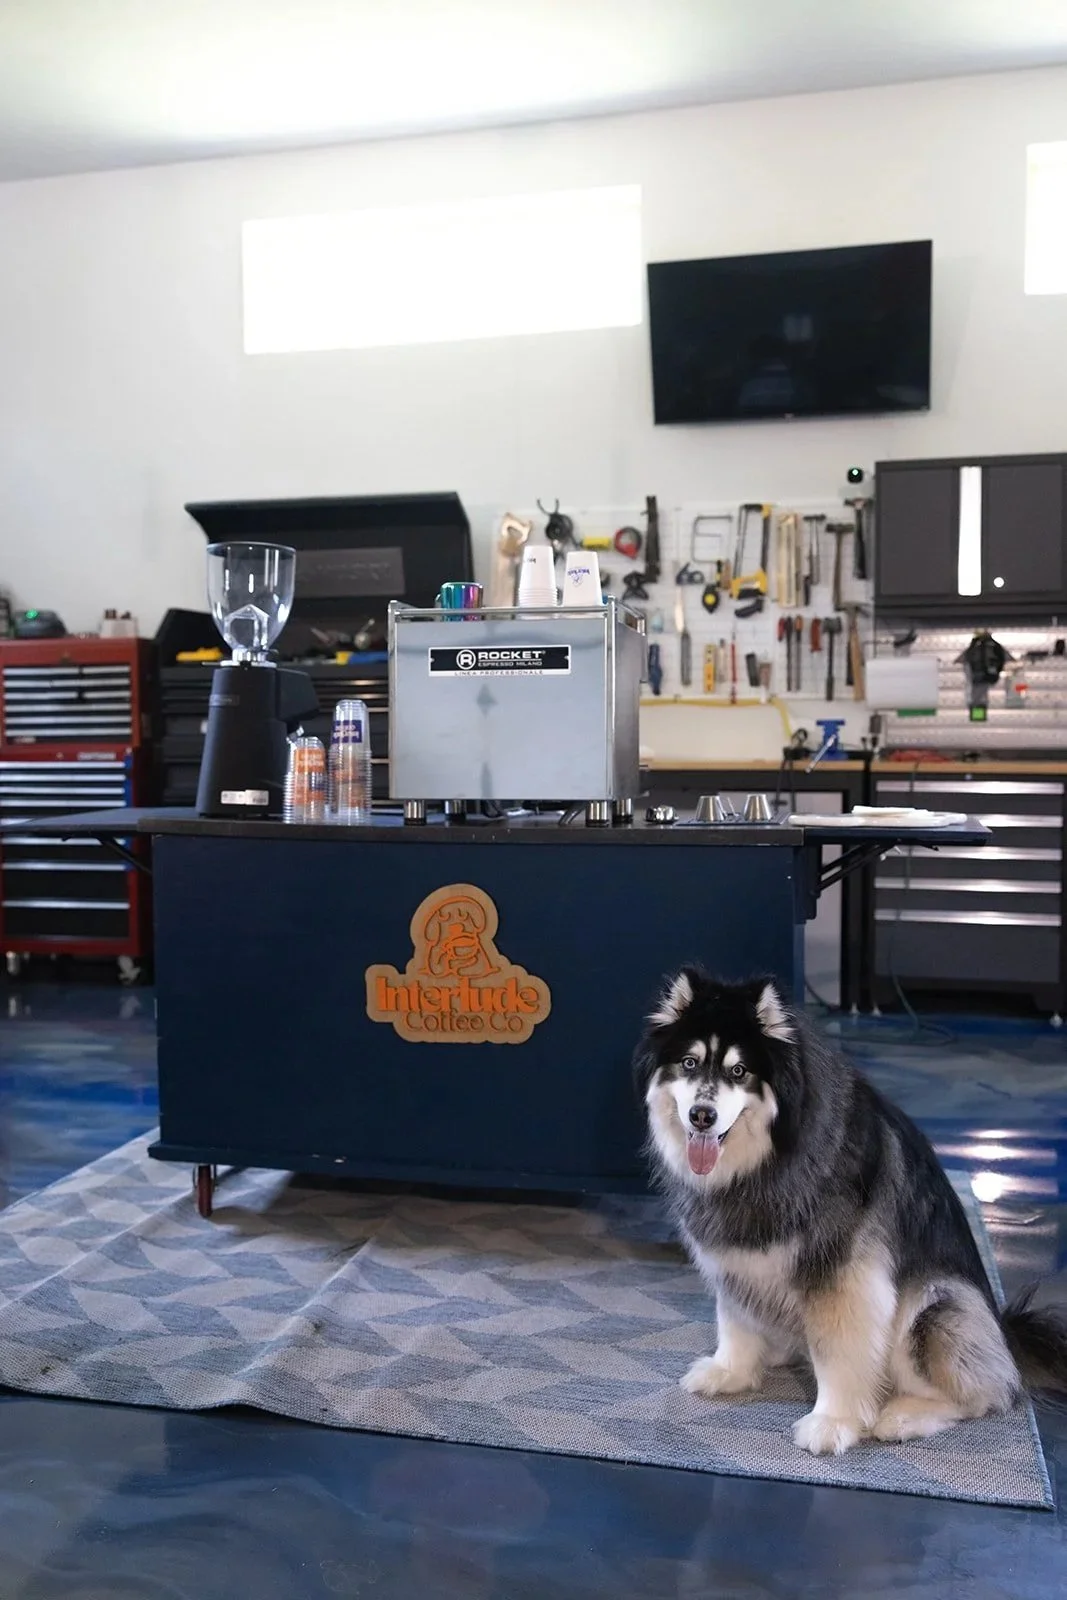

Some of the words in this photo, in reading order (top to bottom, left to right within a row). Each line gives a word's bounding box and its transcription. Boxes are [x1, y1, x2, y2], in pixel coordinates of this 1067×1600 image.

[478, 650, 542, 660] ROCKET
[375, 975, 540, 1014] Interlude
[406, 1009, 485, 1033] Coffee
[489, 1011, 524, 1033] Co
